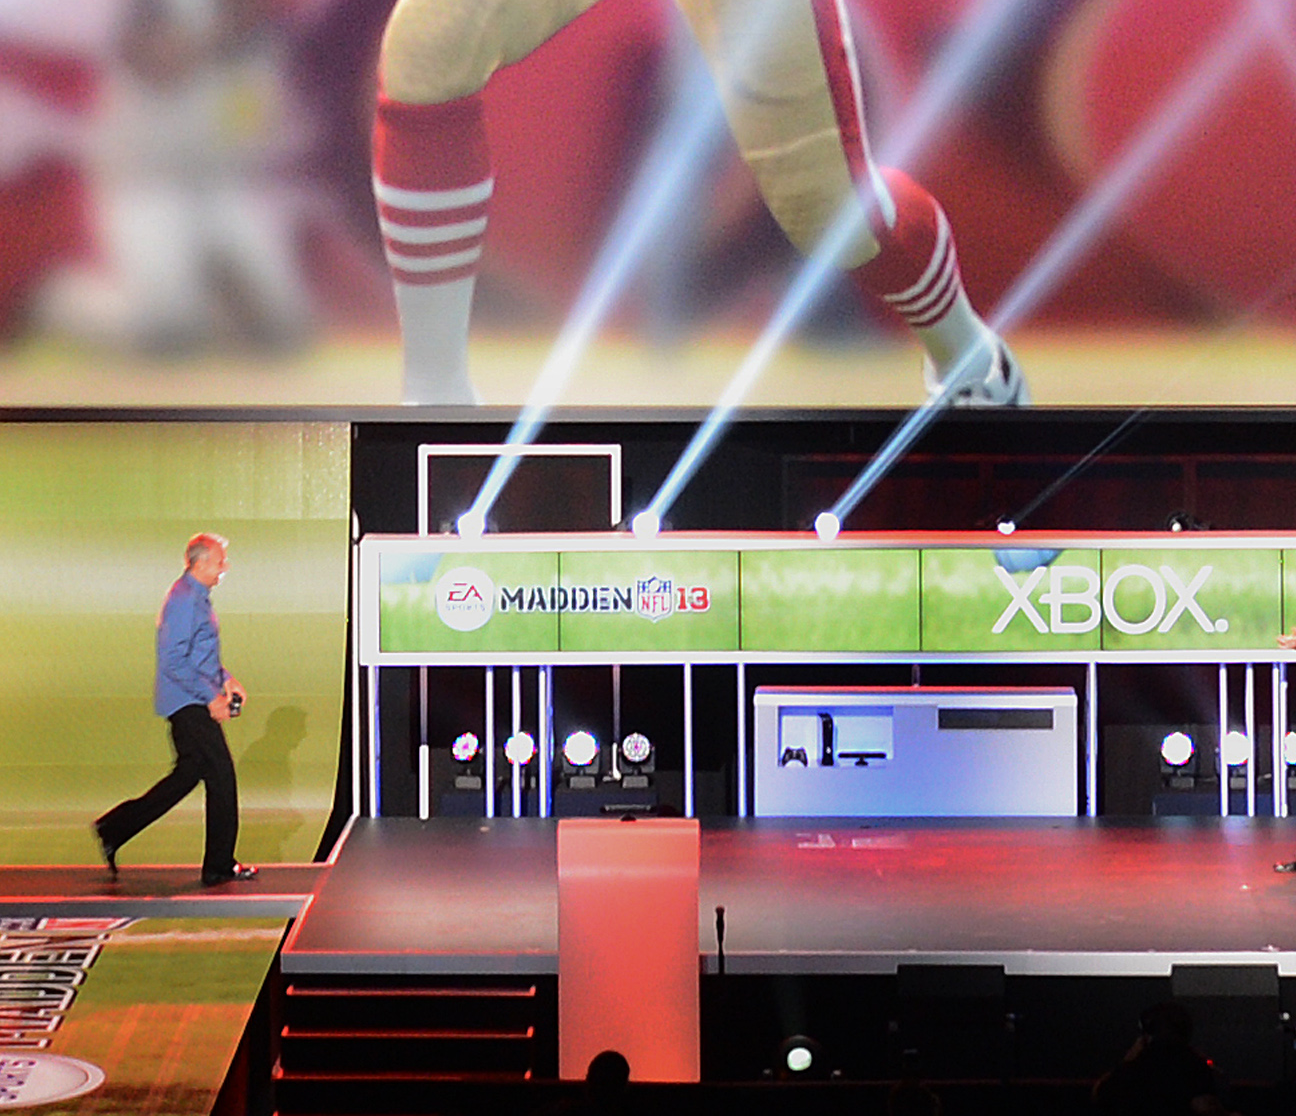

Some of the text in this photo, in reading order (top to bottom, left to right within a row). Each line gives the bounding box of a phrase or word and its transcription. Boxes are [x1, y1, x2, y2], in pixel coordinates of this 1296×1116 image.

[447, 582, 483, 602] EA
[500, 586, 709, 613] MADDEN NFL 13
